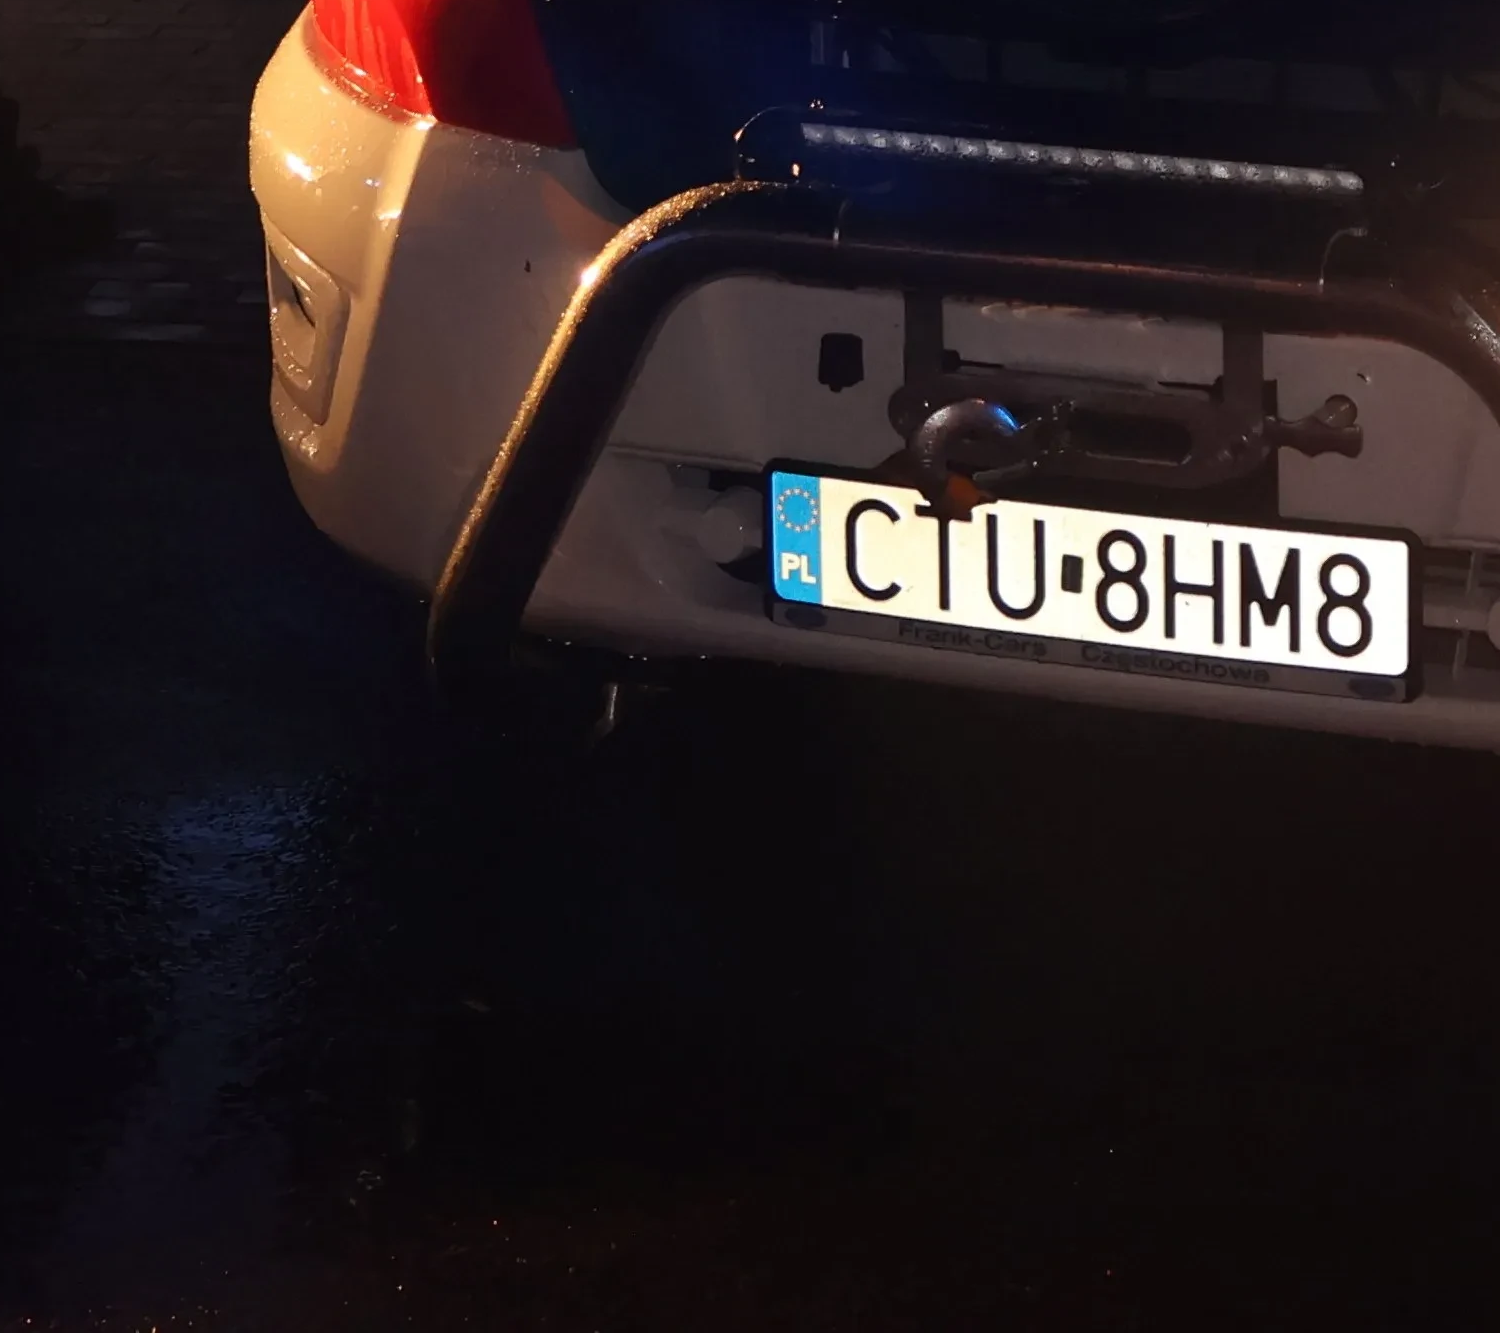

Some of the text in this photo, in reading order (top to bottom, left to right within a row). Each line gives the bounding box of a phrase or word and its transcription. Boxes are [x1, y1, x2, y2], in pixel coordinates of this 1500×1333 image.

[780, 551, 817, 584] PL
[844, 497, 1374, 659] CTU 8HM8
